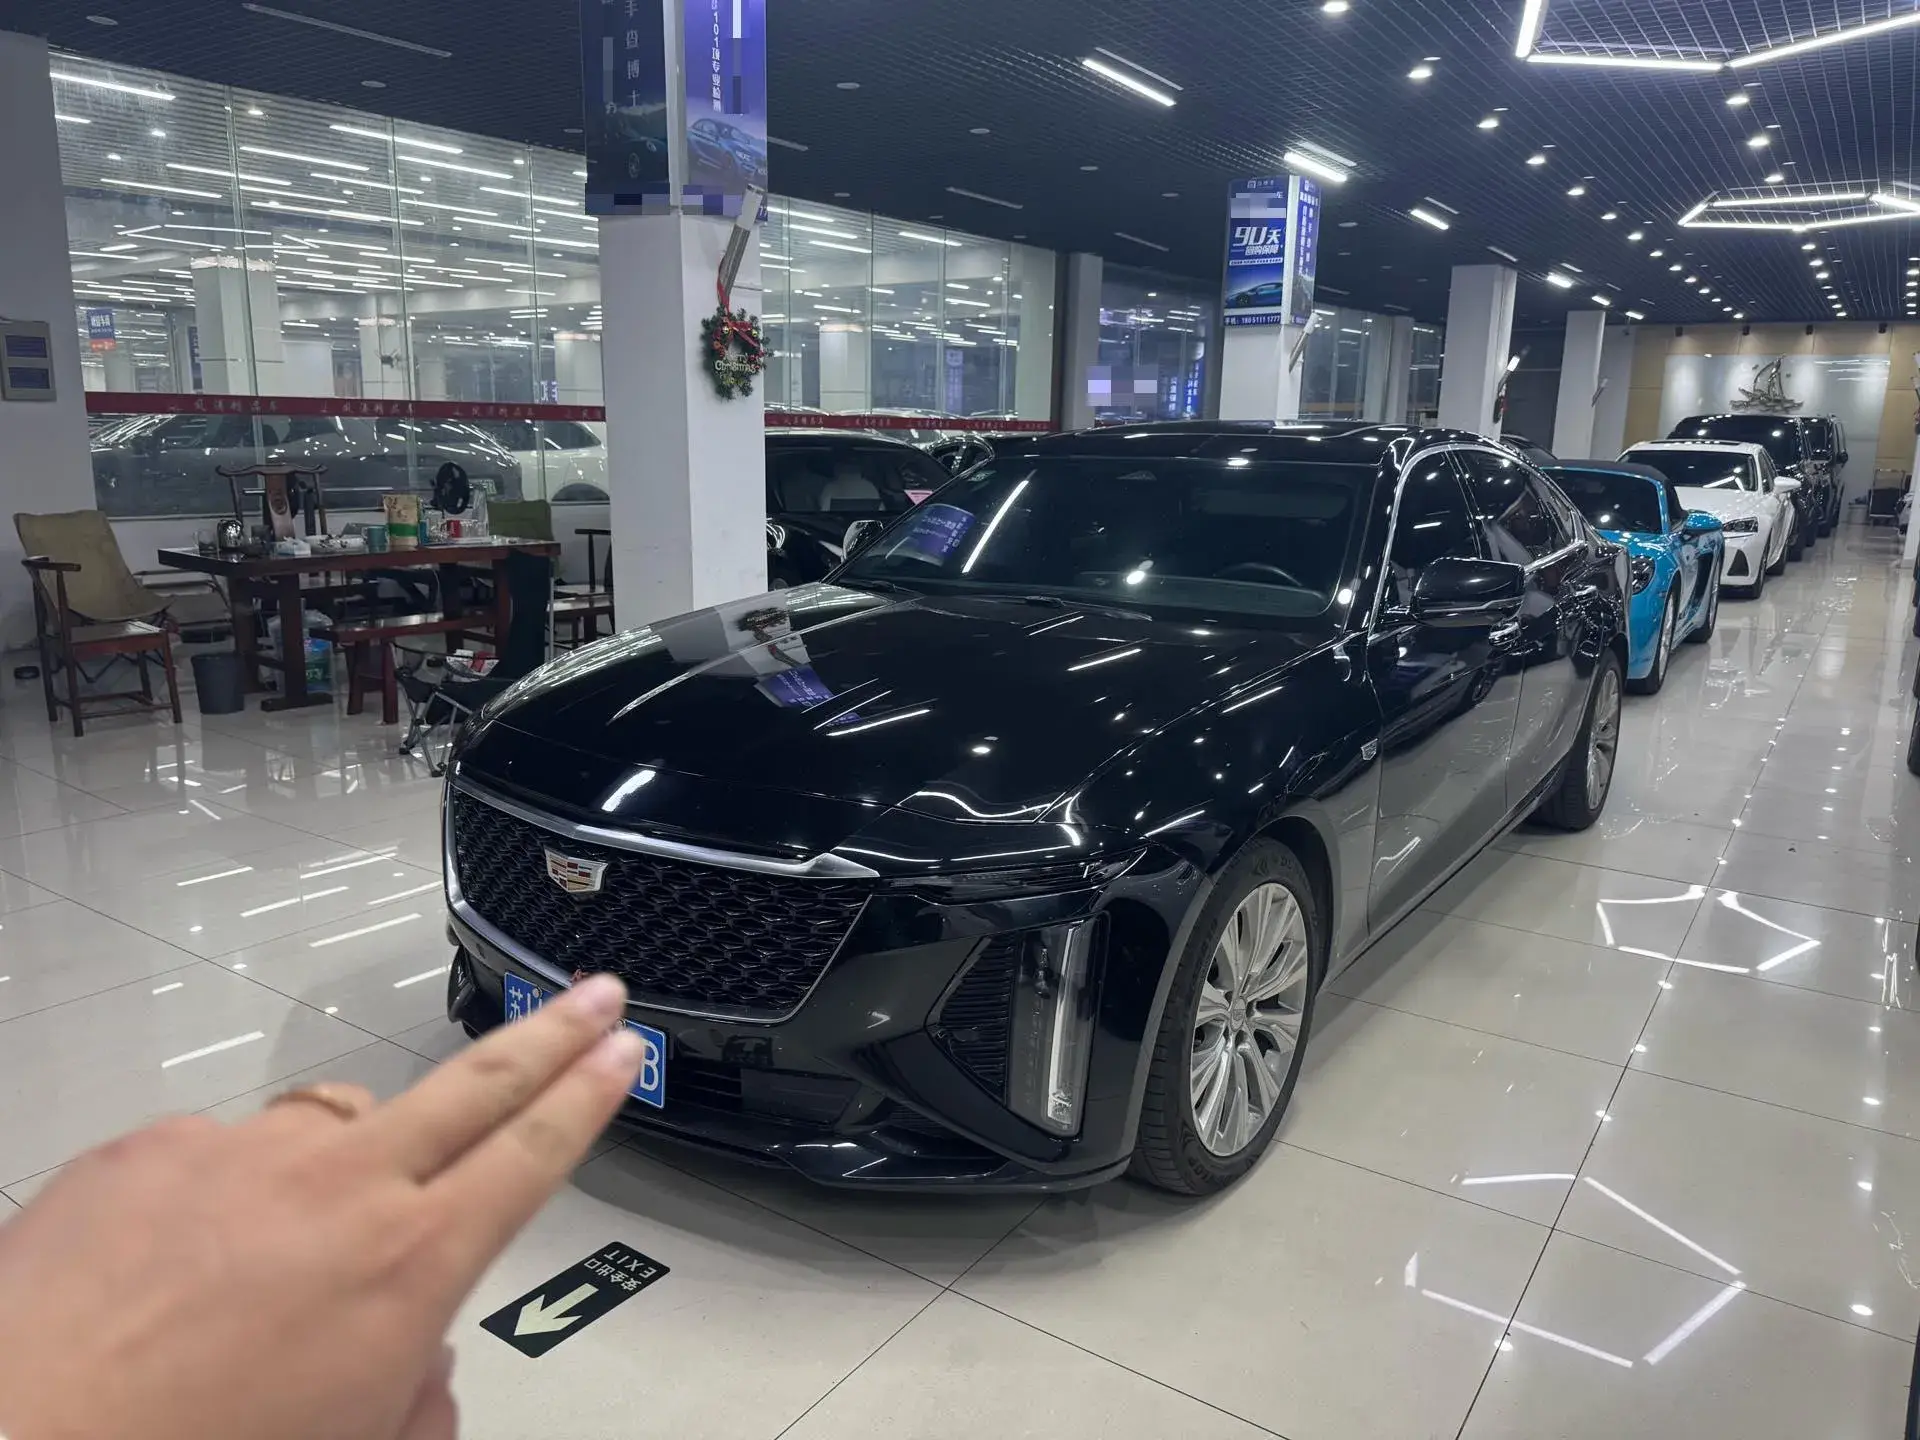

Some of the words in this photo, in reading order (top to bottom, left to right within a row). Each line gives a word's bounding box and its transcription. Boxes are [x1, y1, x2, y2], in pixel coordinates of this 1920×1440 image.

[583, 1257, 643, 1292] 安全出口
[603, 1249, 657, 1279] EXIT
